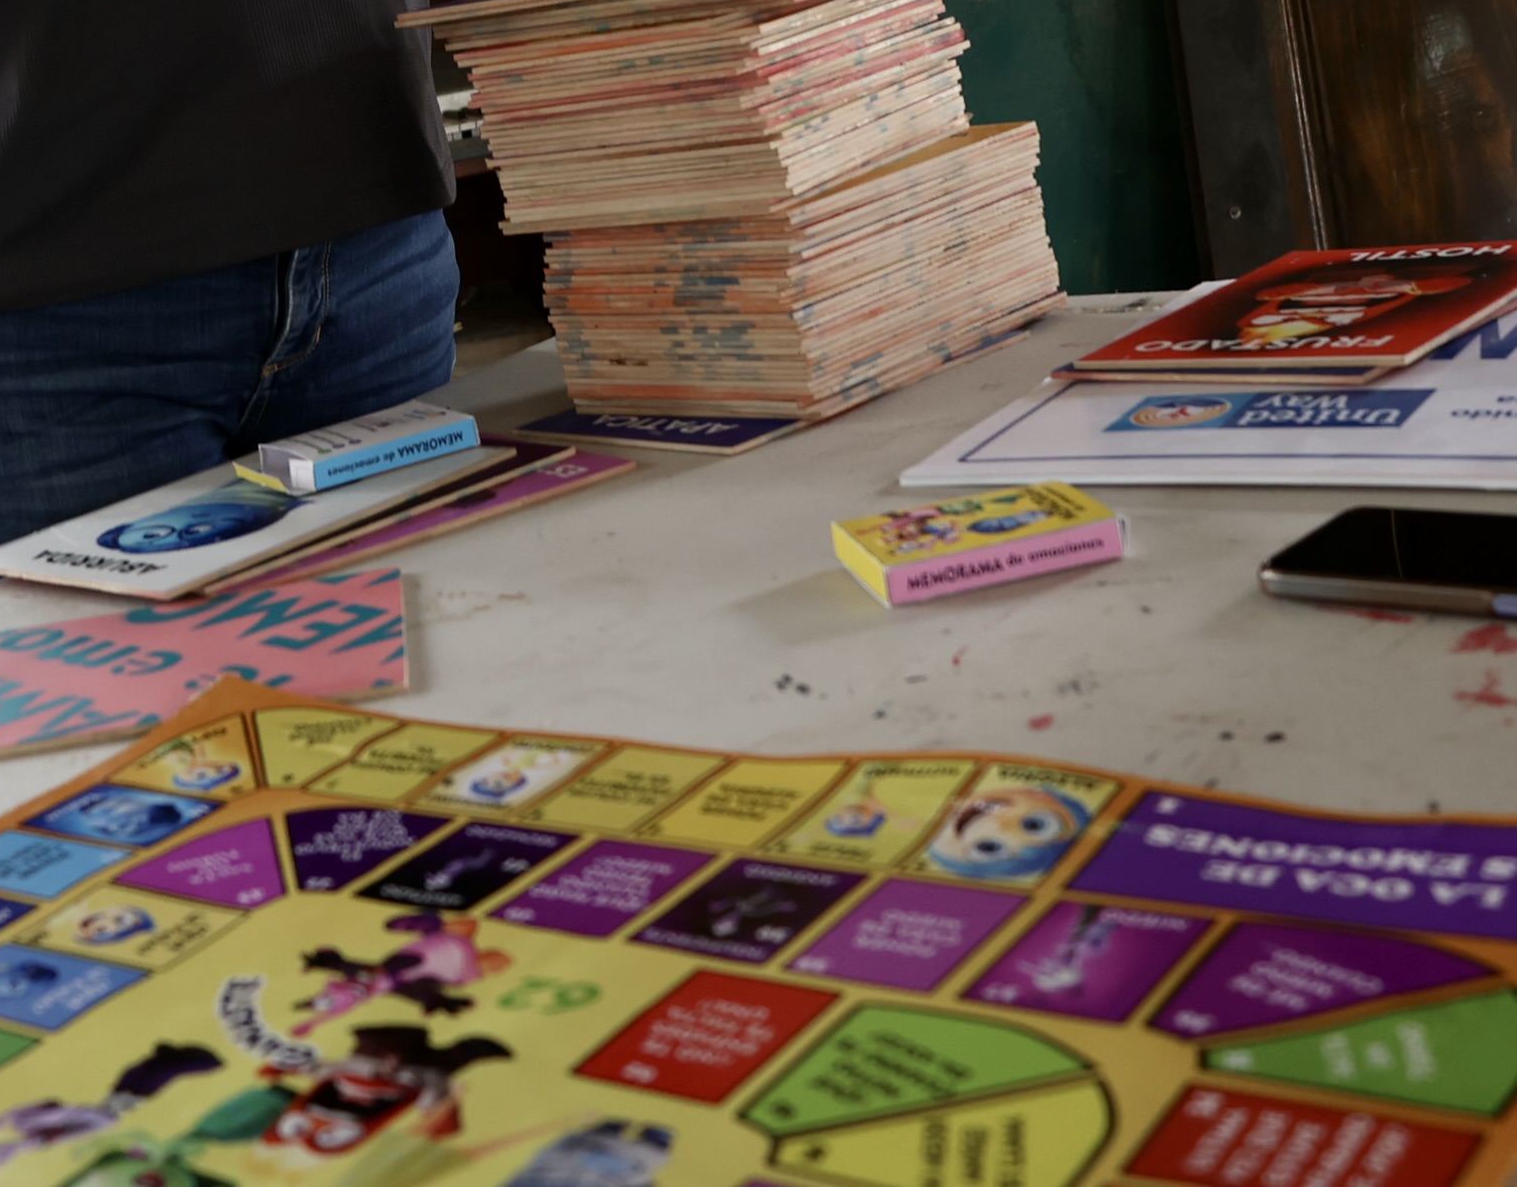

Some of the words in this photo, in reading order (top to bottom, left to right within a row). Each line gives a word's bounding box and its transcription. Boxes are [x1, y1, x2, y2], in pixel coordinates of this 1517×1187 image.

[1349, 243, 1513, 262] HOSTIL
[1134, 334, 1396, 352] FRUSTADO
[1252, 392, 1349, 410] Way
[1236, 407, 1403, 427] United
[382, 451, 396, 464] de
[396, 430, 464, 458] MEMORAMA
[327, 455, 381, 477] emociones
[32, 549, 168, 576] ABURRIDA
[905, 557, 1004, 591] MEMORAMA
[1005, 551, 1024, 567] de
[1027, 537, 1105, 563] emociones
[1143, 823, 1473, 880] EMOCIONES
[1199, 859, 1283, 889] DE
[1294, 867, 1417, 903] OCA
[1427, 879, 1509, 910] LA
